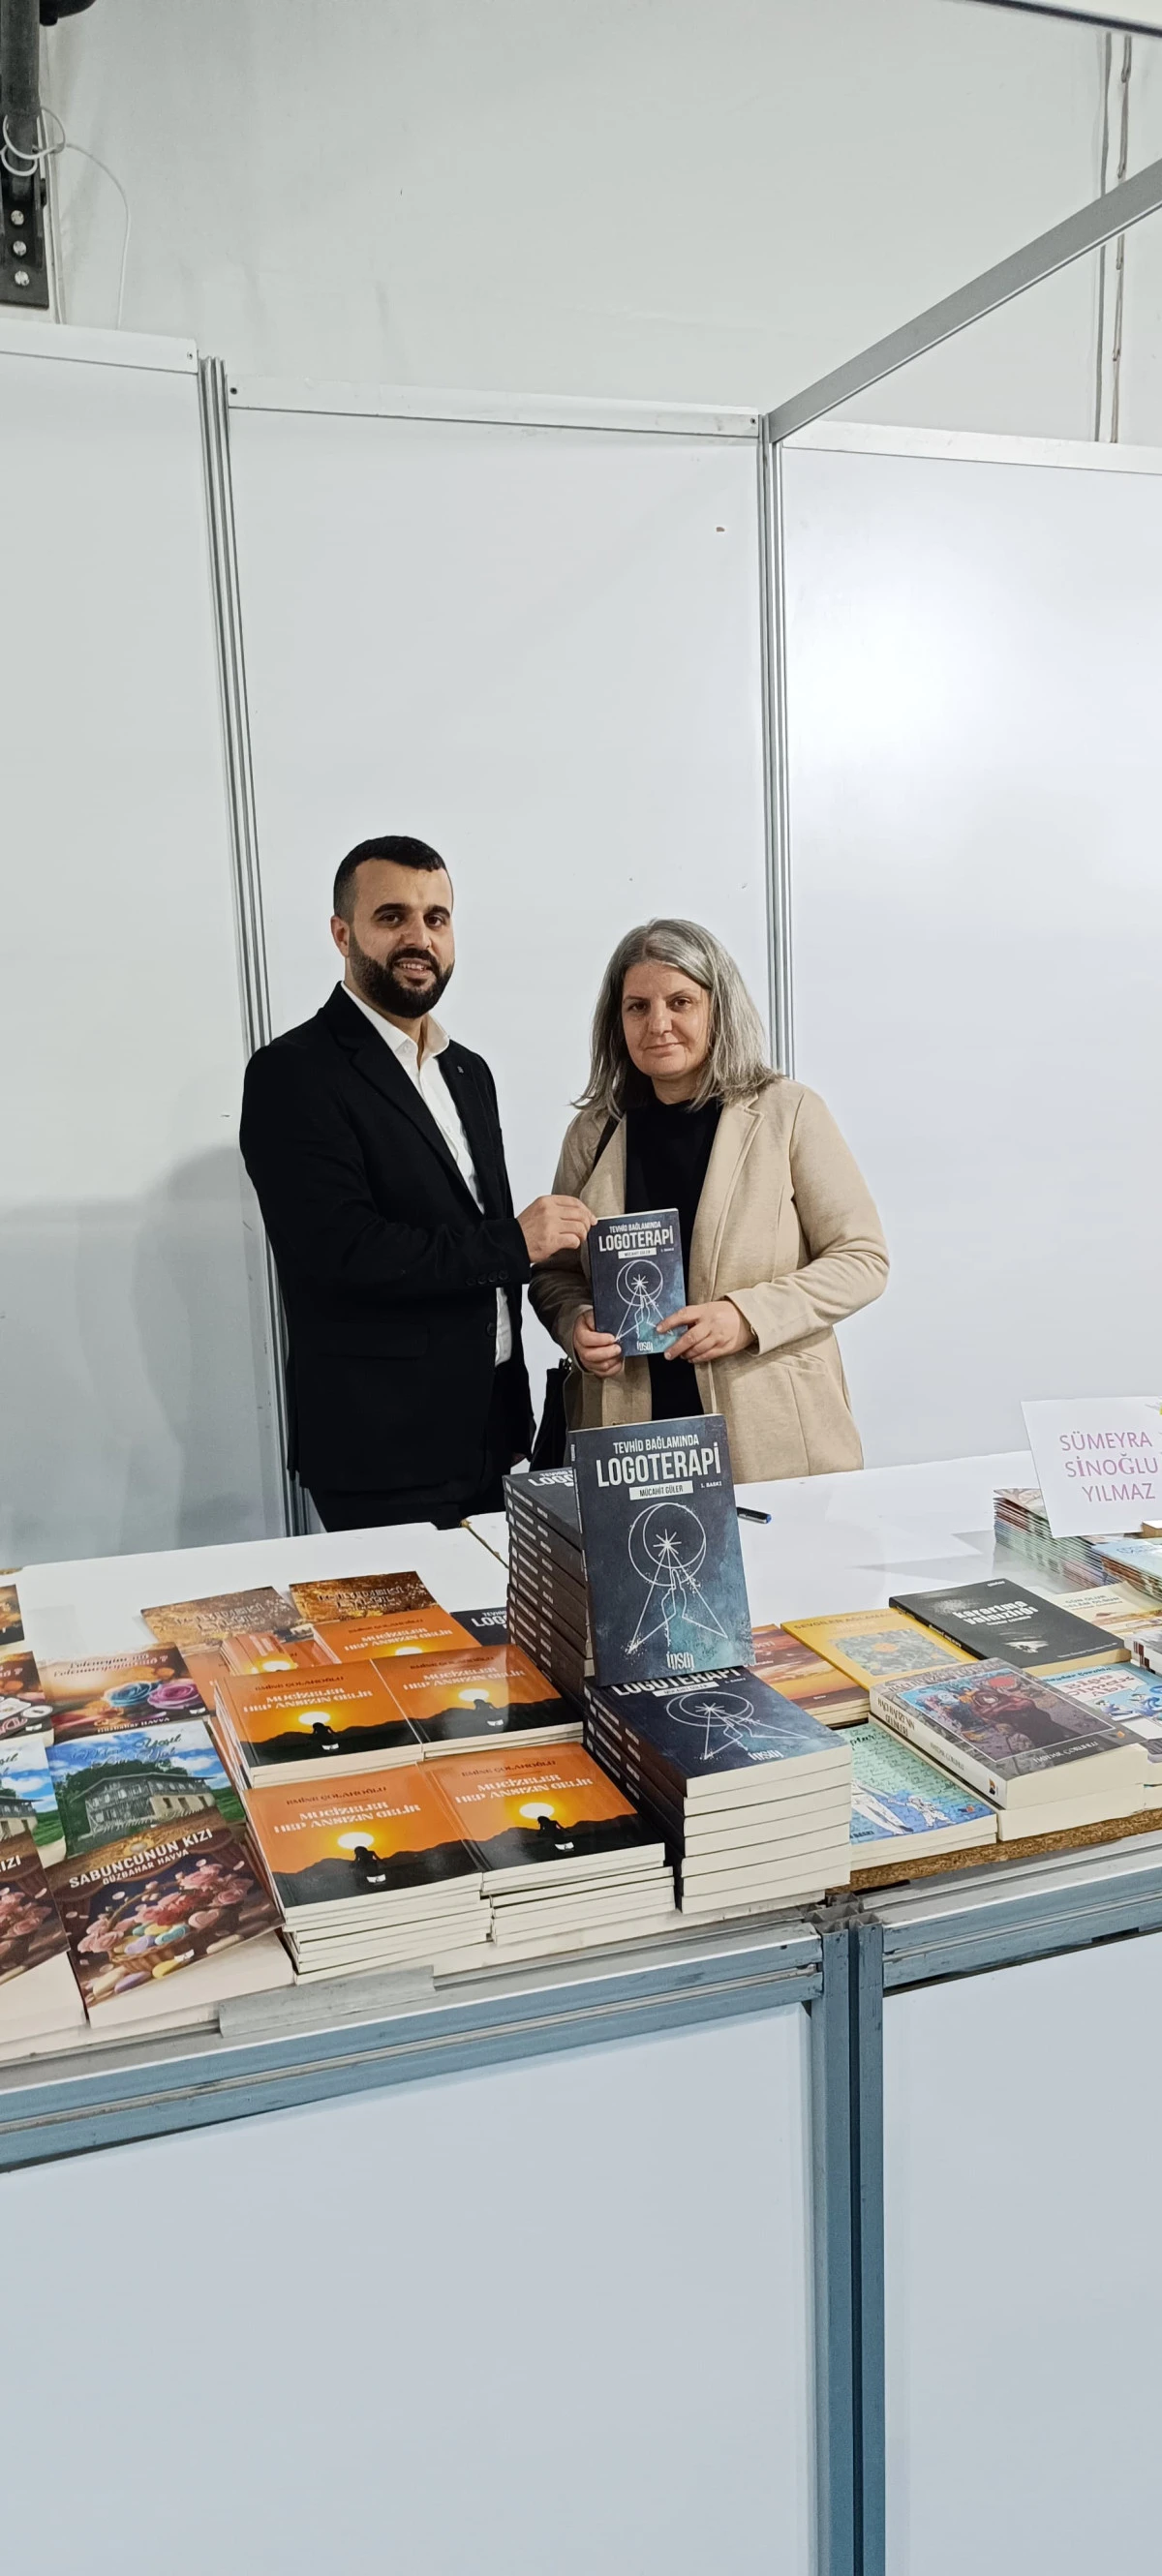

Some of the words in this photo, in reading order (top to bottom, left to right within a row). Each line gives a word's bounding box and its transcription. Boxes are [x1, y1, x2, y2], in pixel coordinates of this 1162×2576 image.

[598, 1226, 674, 1252] LOGOTERAPİ
[613, 1439, 644, 1454] TEVHİD
[645, 1434, 699, 1451] BAĞLAMINDA
[1059, 1431, 1152, 1451] SÜMEYRA
[596, 1441, 721, 1487] LOGOTERAPİ
[1065, 1453, 1158, 1477] SİNOĞLU
[639, 1487, 664, 1498] MÜCAHİT
[665, 1484, 684, 1494] GÜLER
[1082, 1483, 1155, 1502] YILMAZ
[952, 1601, 1028, 1619] karartma
[476, 1773, 562, 1792] MUCİZELER
[455, 1794, 486, 1804] HEP
[490, 1785, 550, 1799] ANSIZIN
[299, 1802, 388, 1821] MUCİZELER
[273, 1823, 307, 1834] HEP
[310, 1812, 374, 1828] ANSIZIN
[69, 1840, 179, 1889] SABUNCUNUN
[181, 1828, 213, 1848] KIZI
[157, 1848, 190, 1866] HAVVA
